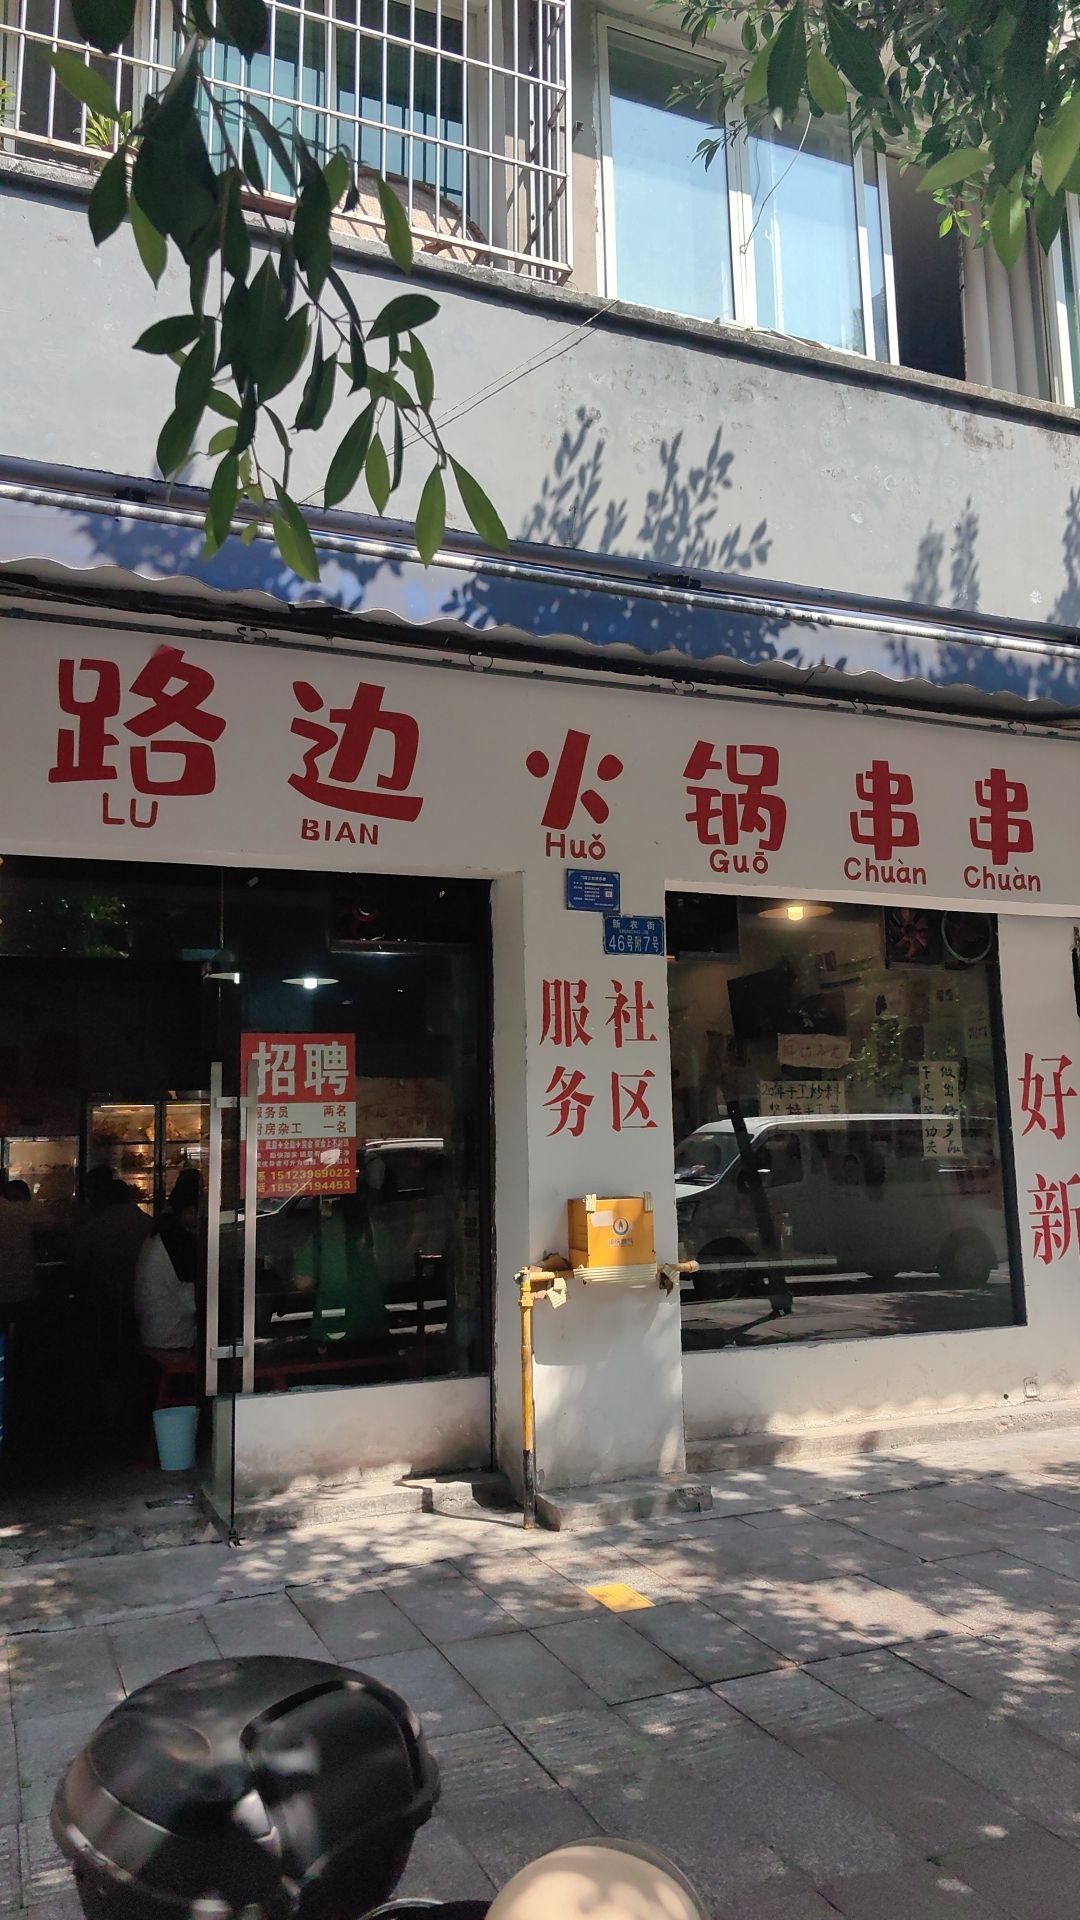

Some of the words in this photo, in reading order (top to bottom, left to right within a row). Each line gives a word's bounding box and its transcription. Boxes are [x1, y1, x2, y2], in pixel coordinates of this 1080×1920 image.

[102, 792, 159, 829] LU
[300, 818, 379, 845] BIAN
[545, 832, 606, 861] Huǒ
[709, 849, 769, 875] Guō
[843, 856, 927, 886] Chuàn
[963, 865, 1041, 892] Chuàn
[612, 918, 655, 931] 新农街
[252, 1041, 349, 1096] 招聘
[323, 1105, 347, 1118] 两名
[323, 1120, 347, 1133] 一名
[270, 1168, 351, 1181] 15123969022
